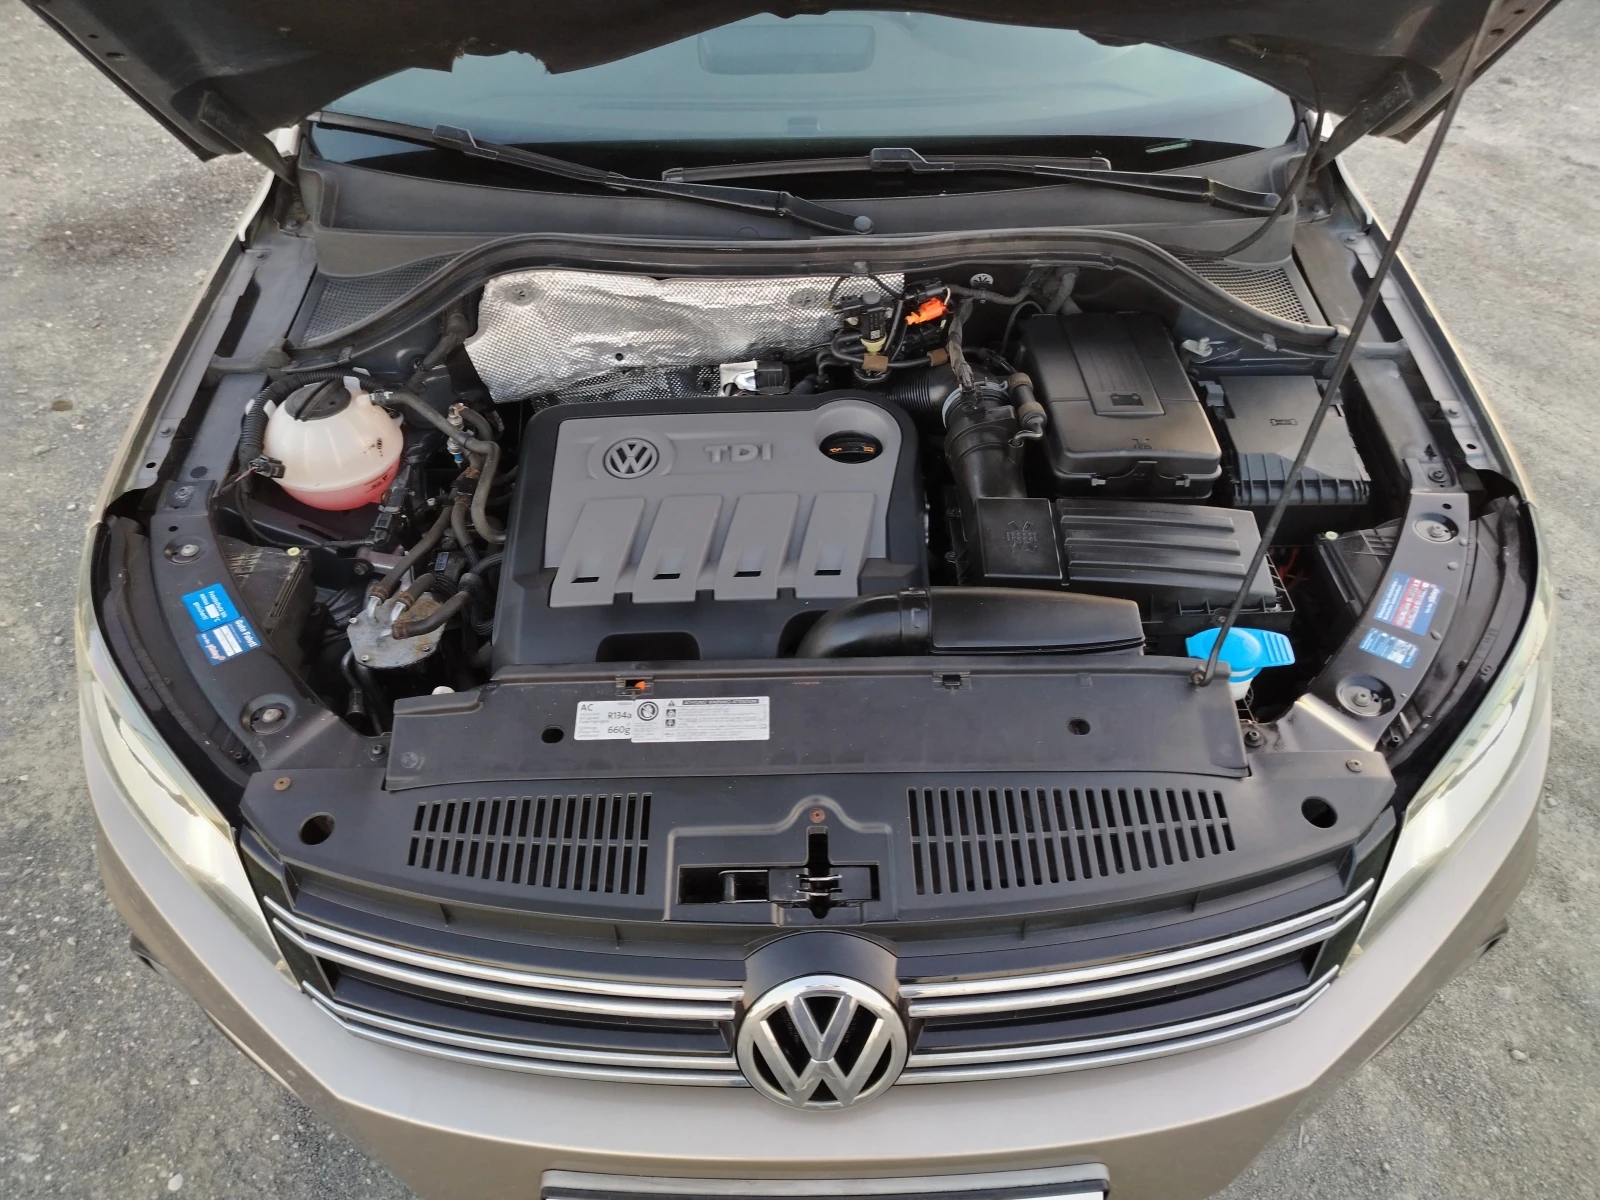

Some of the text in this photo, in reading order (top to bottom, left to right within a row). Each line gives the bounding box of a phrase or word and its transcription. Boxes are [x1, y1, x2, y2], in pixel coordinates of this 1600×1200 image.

[705, 443, 772, 464] TDI
[580, 703, 594, 712] AC
[607, 711, 633, 720] R134a
[607, 725, 631, 736] 660g
